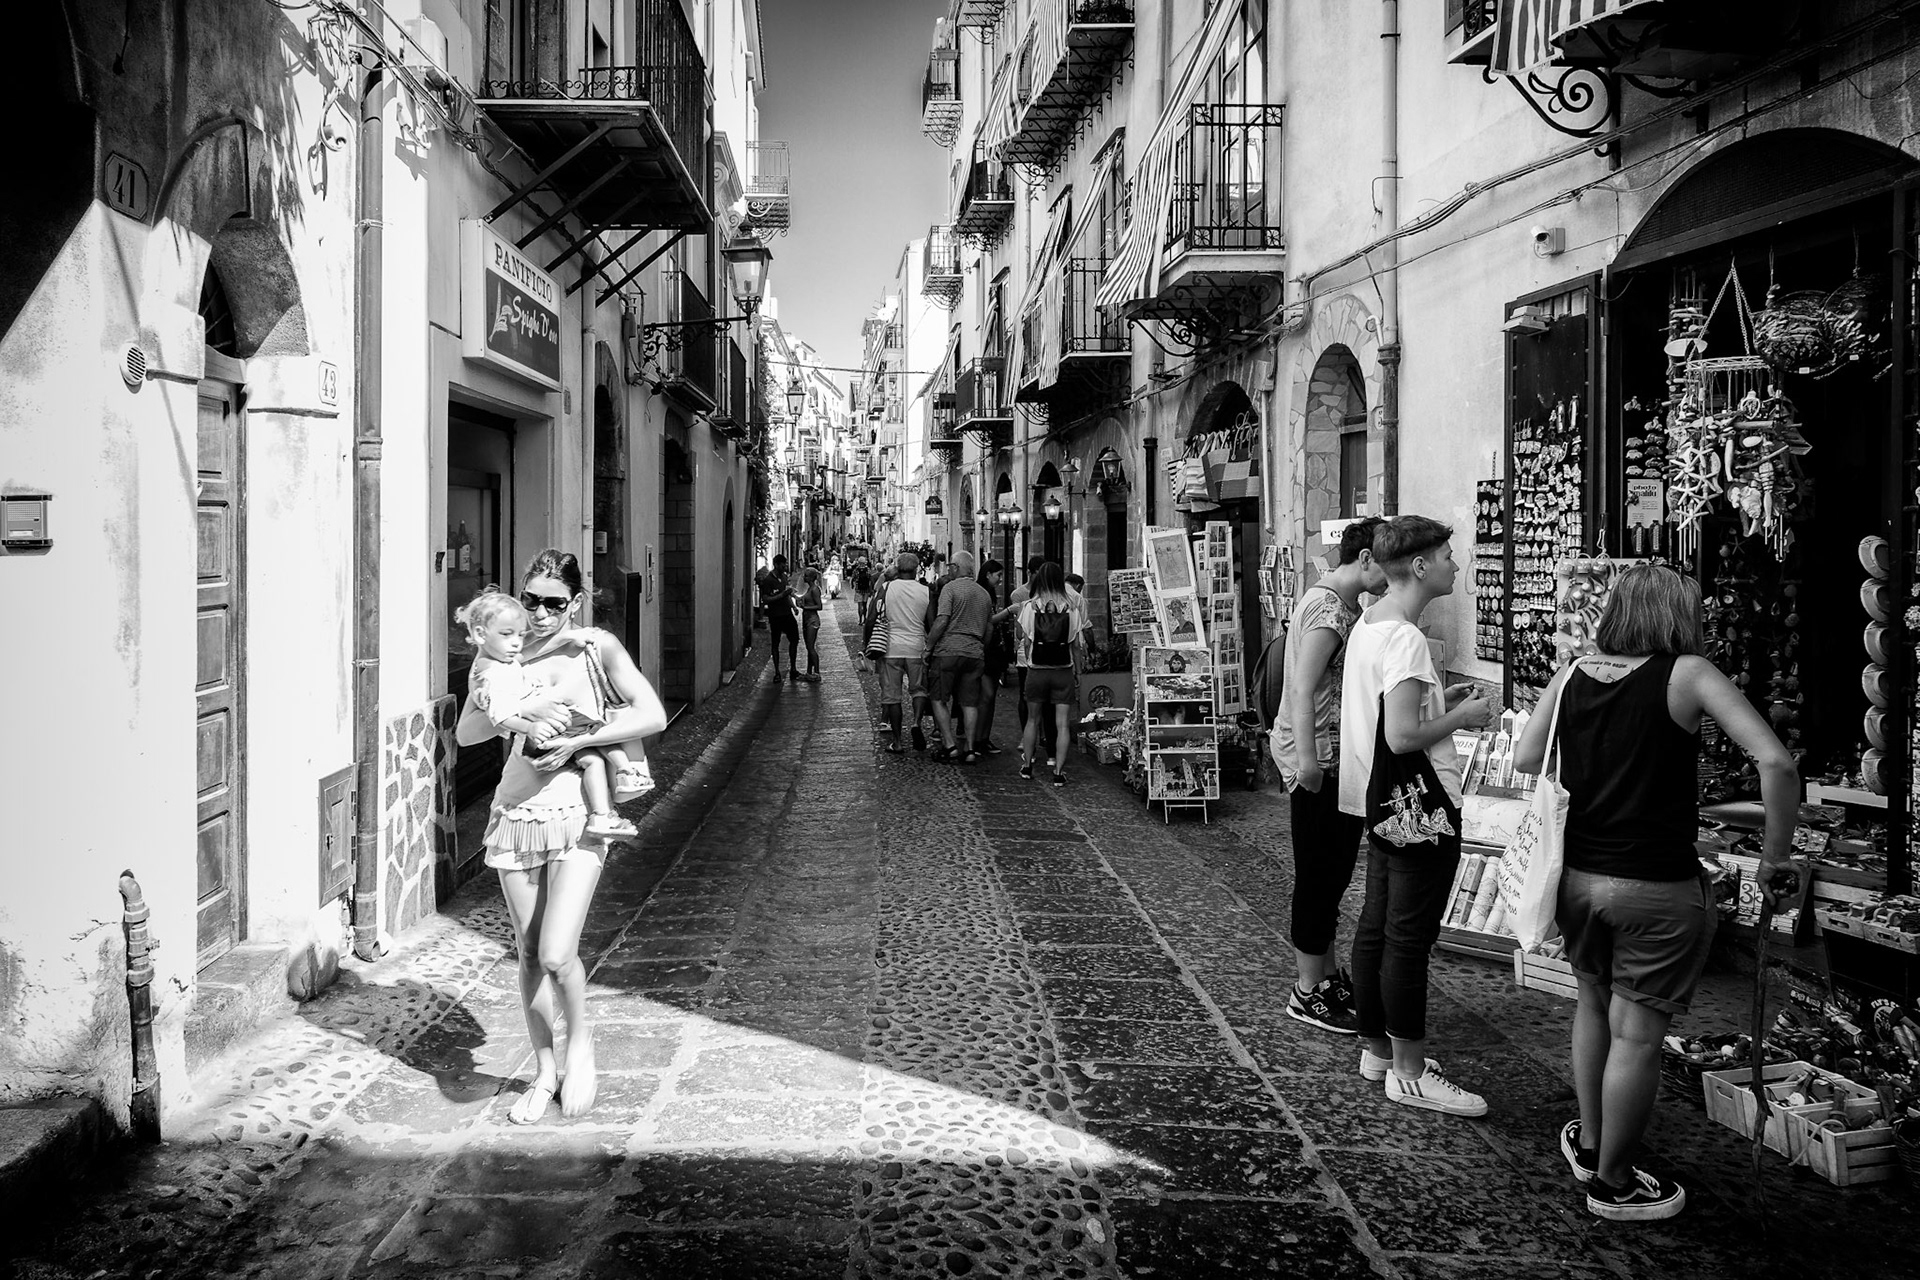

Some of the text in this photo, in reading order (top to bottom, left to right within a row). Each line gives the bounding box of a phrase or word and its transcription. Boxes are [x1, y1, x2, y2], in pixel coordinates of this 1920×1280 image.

[113, 163, 135, 209] 41
[494, 242, 552, 303] PANIFICIO
[322, 368, 337, 399] 43
[1311, 1001, 1328, 1015] N
